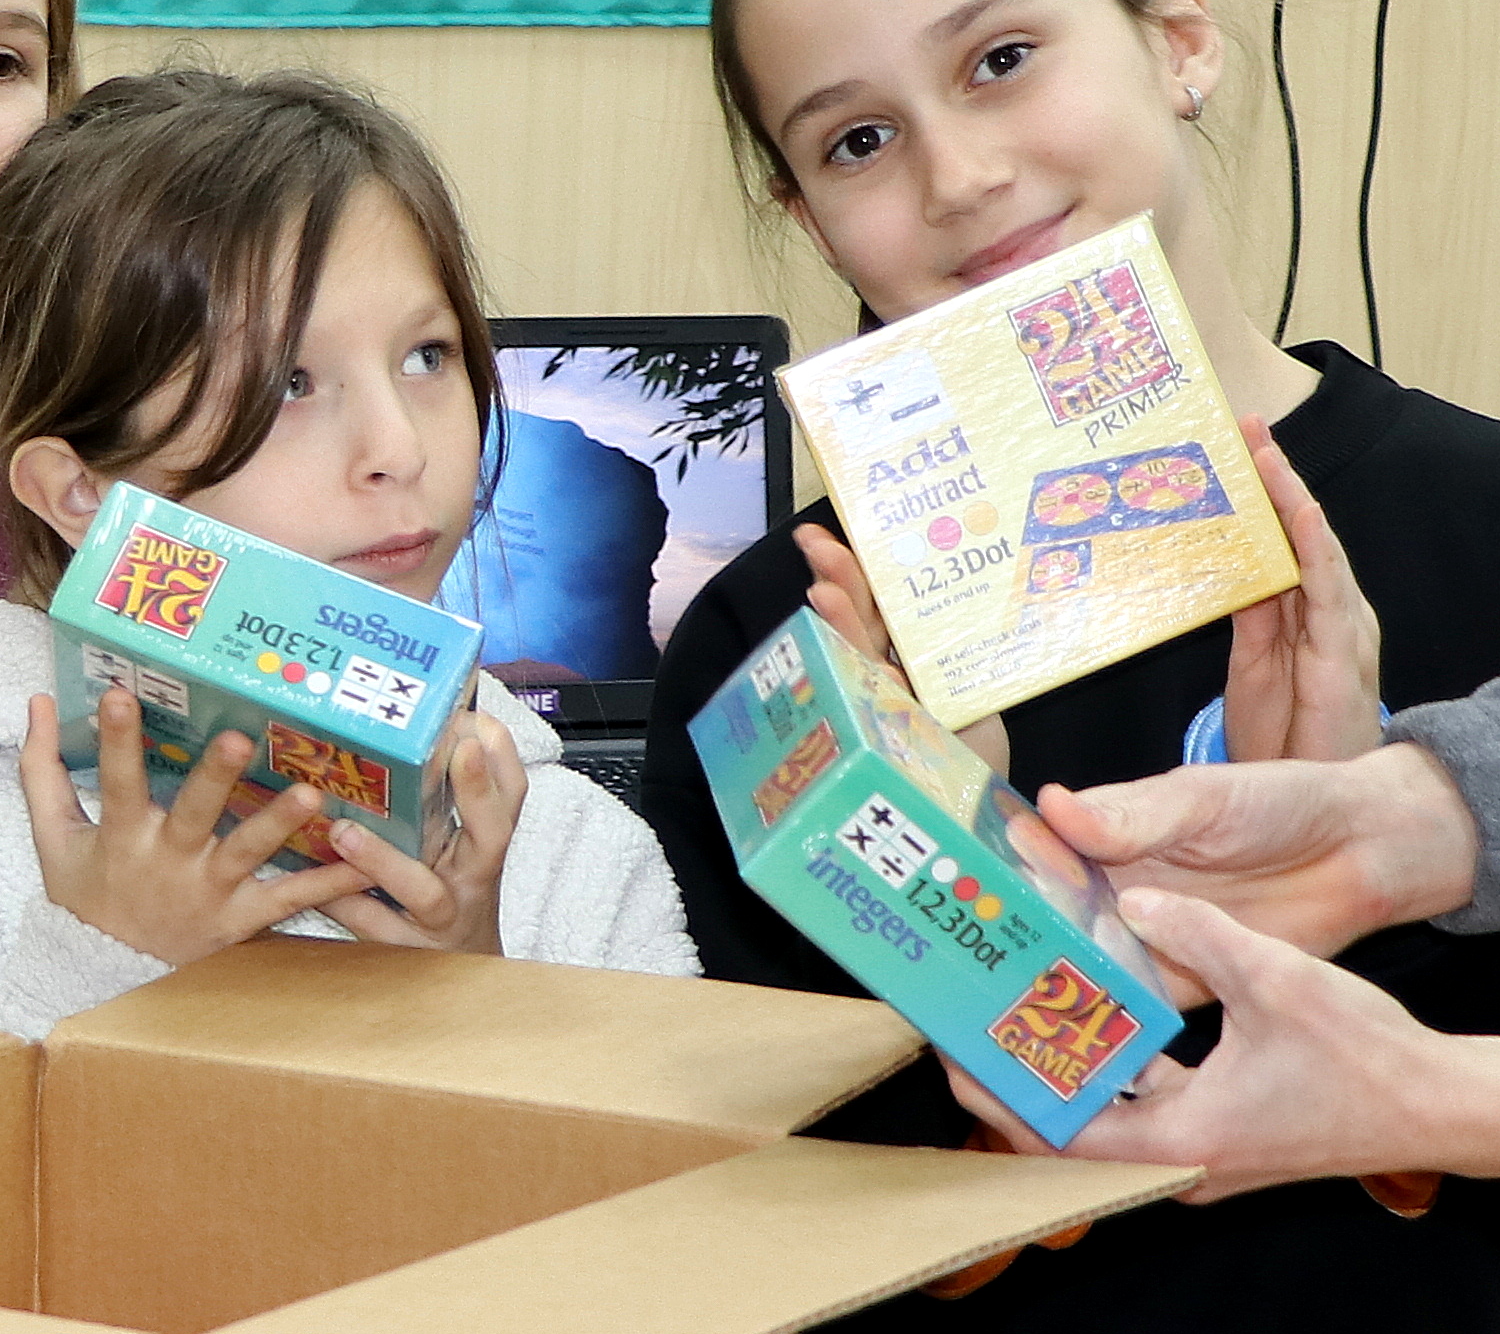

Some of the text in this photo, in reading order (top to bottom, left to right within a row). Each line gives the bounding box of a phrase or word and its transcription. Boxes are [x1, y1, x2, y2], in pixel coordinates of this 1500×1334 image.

[1016, 267, 1135, 378] 24
[1055, 340, 1160, 423] GAME
[1083, 363, 1192, 449] PRIMER
[867, 425, 973, 494] Add
[869, 465, 988, 532] Subtract
[128, 533, 221, 572] GAME
[120, 557, 205, 632] 24
[315, 602, 442, 674] Integers
[805, 847, 934, 965] integers
[1017, 969, 1122, 1059] 24
[995, 1024, 1091, 1091] GAME
